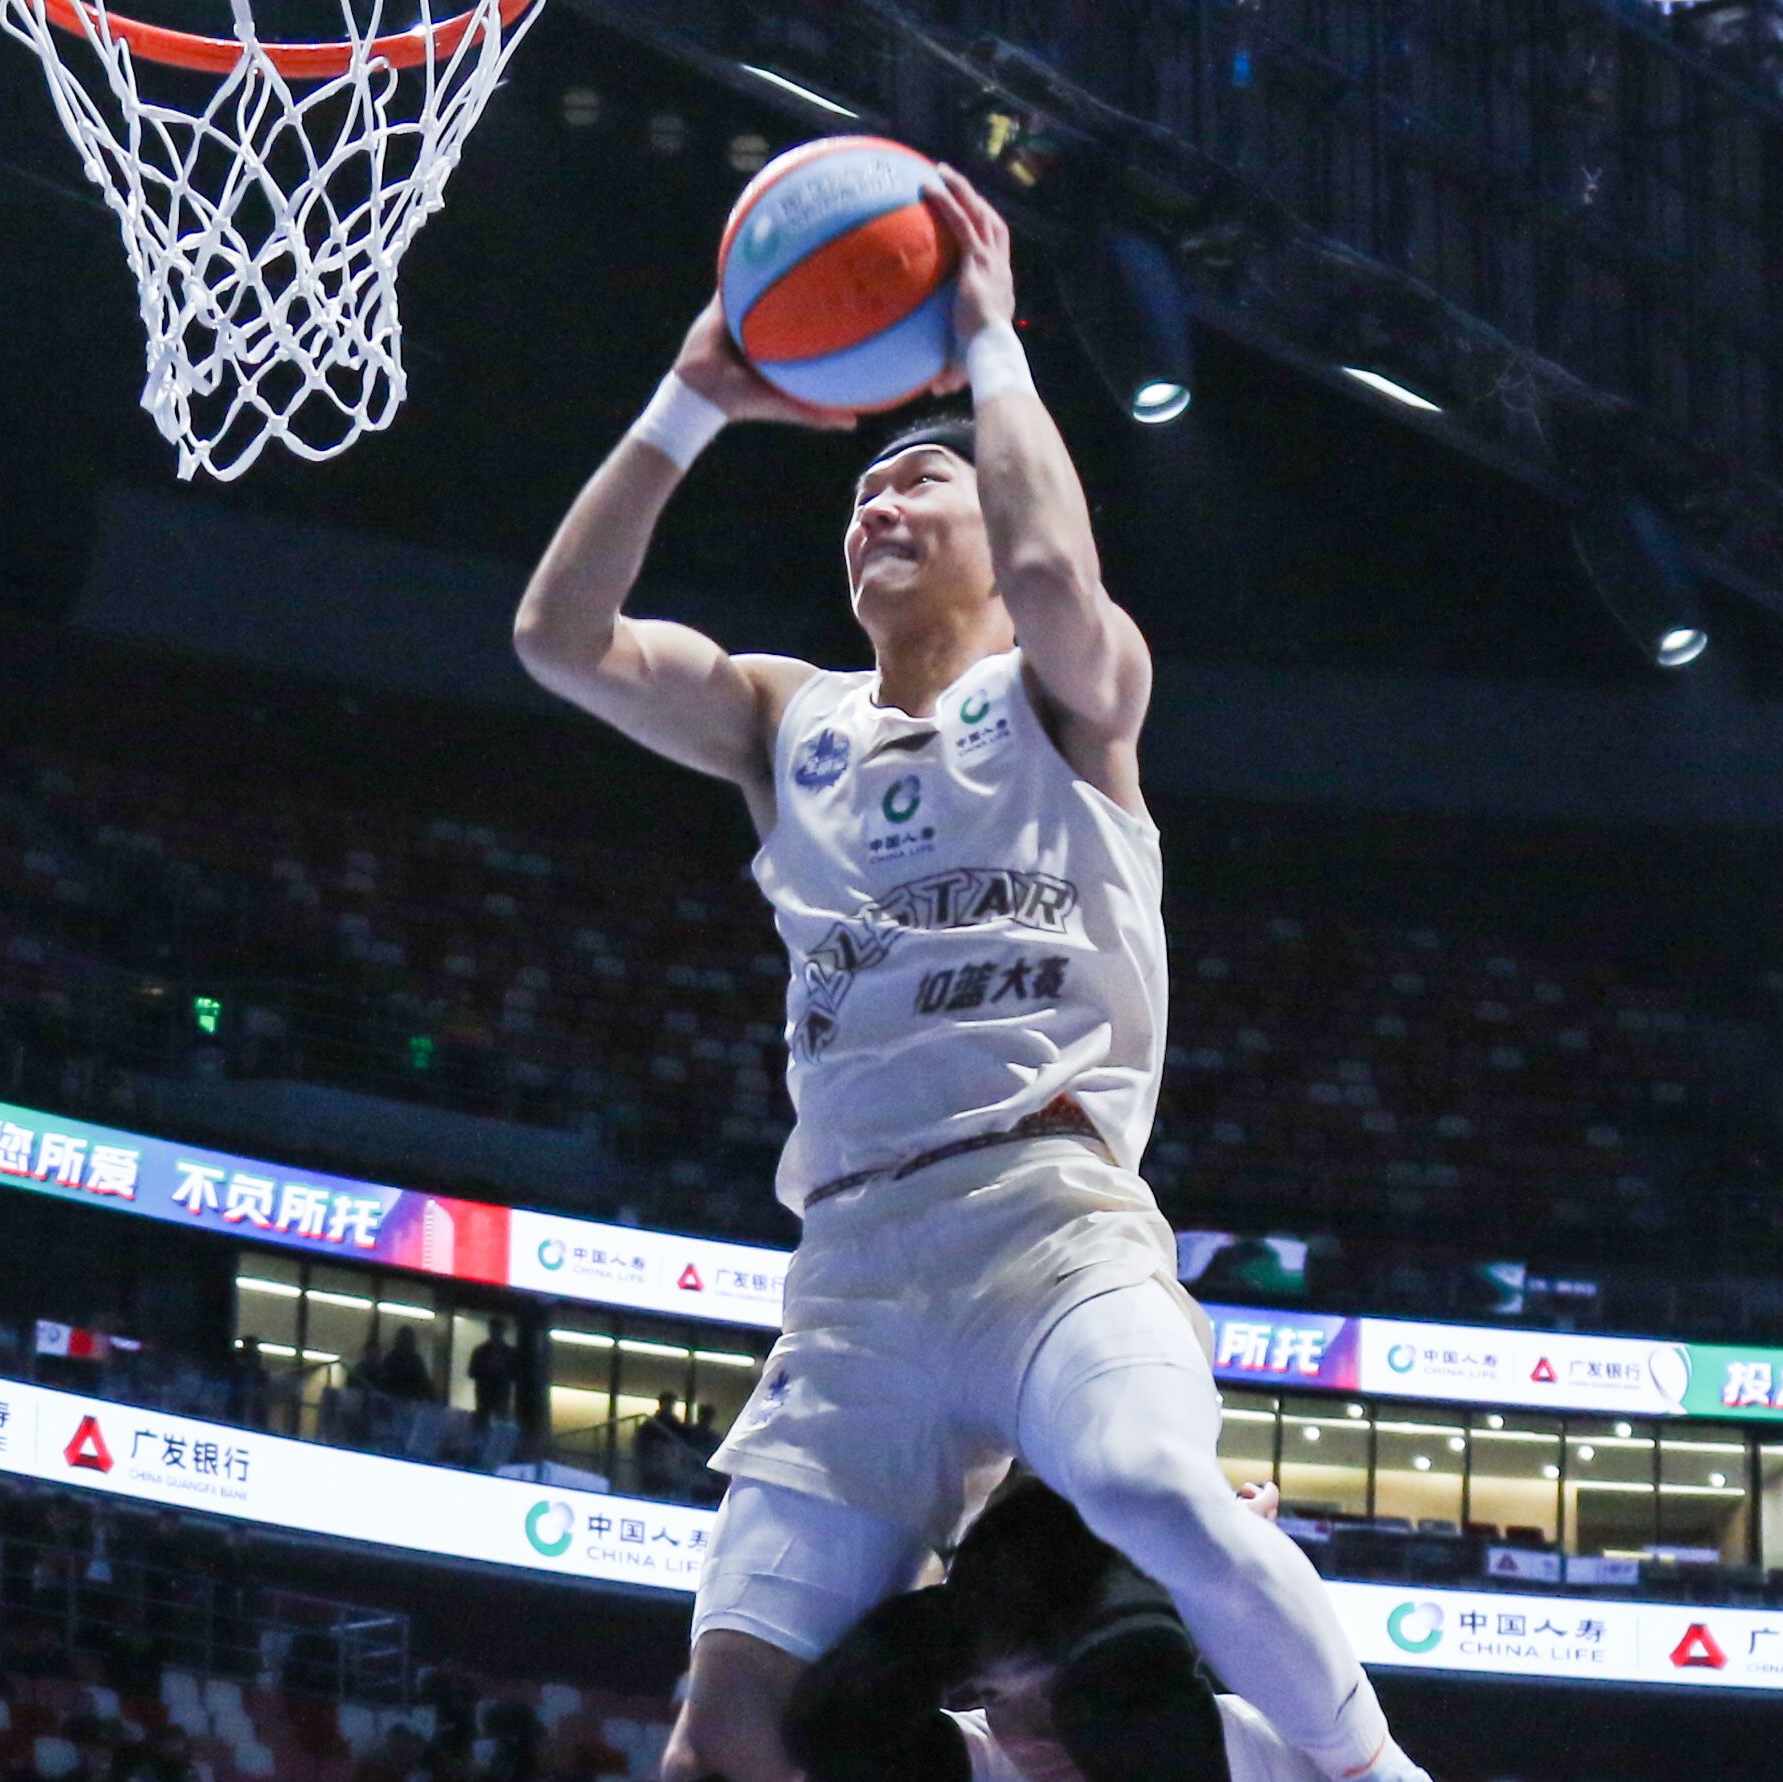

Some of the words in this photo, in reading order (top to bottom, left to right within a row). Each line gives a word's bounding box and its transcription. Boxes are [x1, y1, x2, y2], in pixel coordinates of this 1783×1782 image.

[171, 1158, 384, 1250] 不负所托
[573, 1246, 647, 1272] 中国人寿
[573, 1263, 614, 1280] CHINA
[618, 1271, 646, 1285] LIFE
[715, 1267, 785, 1292] 广发银行
[1210, 1320, 1325, 1377] 所托
[1423, 1348, 1499, 1369] 中国人寿
[1569, 1358, 1641, 1381] 广发银行
[129, 1428, 250, 1482] 广发银行
[128, 1467, 163, 1487] CHINA
[166, 1474, 218, 1496] GUANGFA
[220, 1486, 249, 1502] BANK
[587, 1512, 710, 1553] 中国人寿
[587, 1546, 657, 1568] CHINA
[665, 1558, 702, 1574] LIF
[1459, 1609, 1608, 1644] 中国人寿
[1459, 1640, 1540, 1660] CHINA
[1551, 1646, 1605, 1664] LIFE
